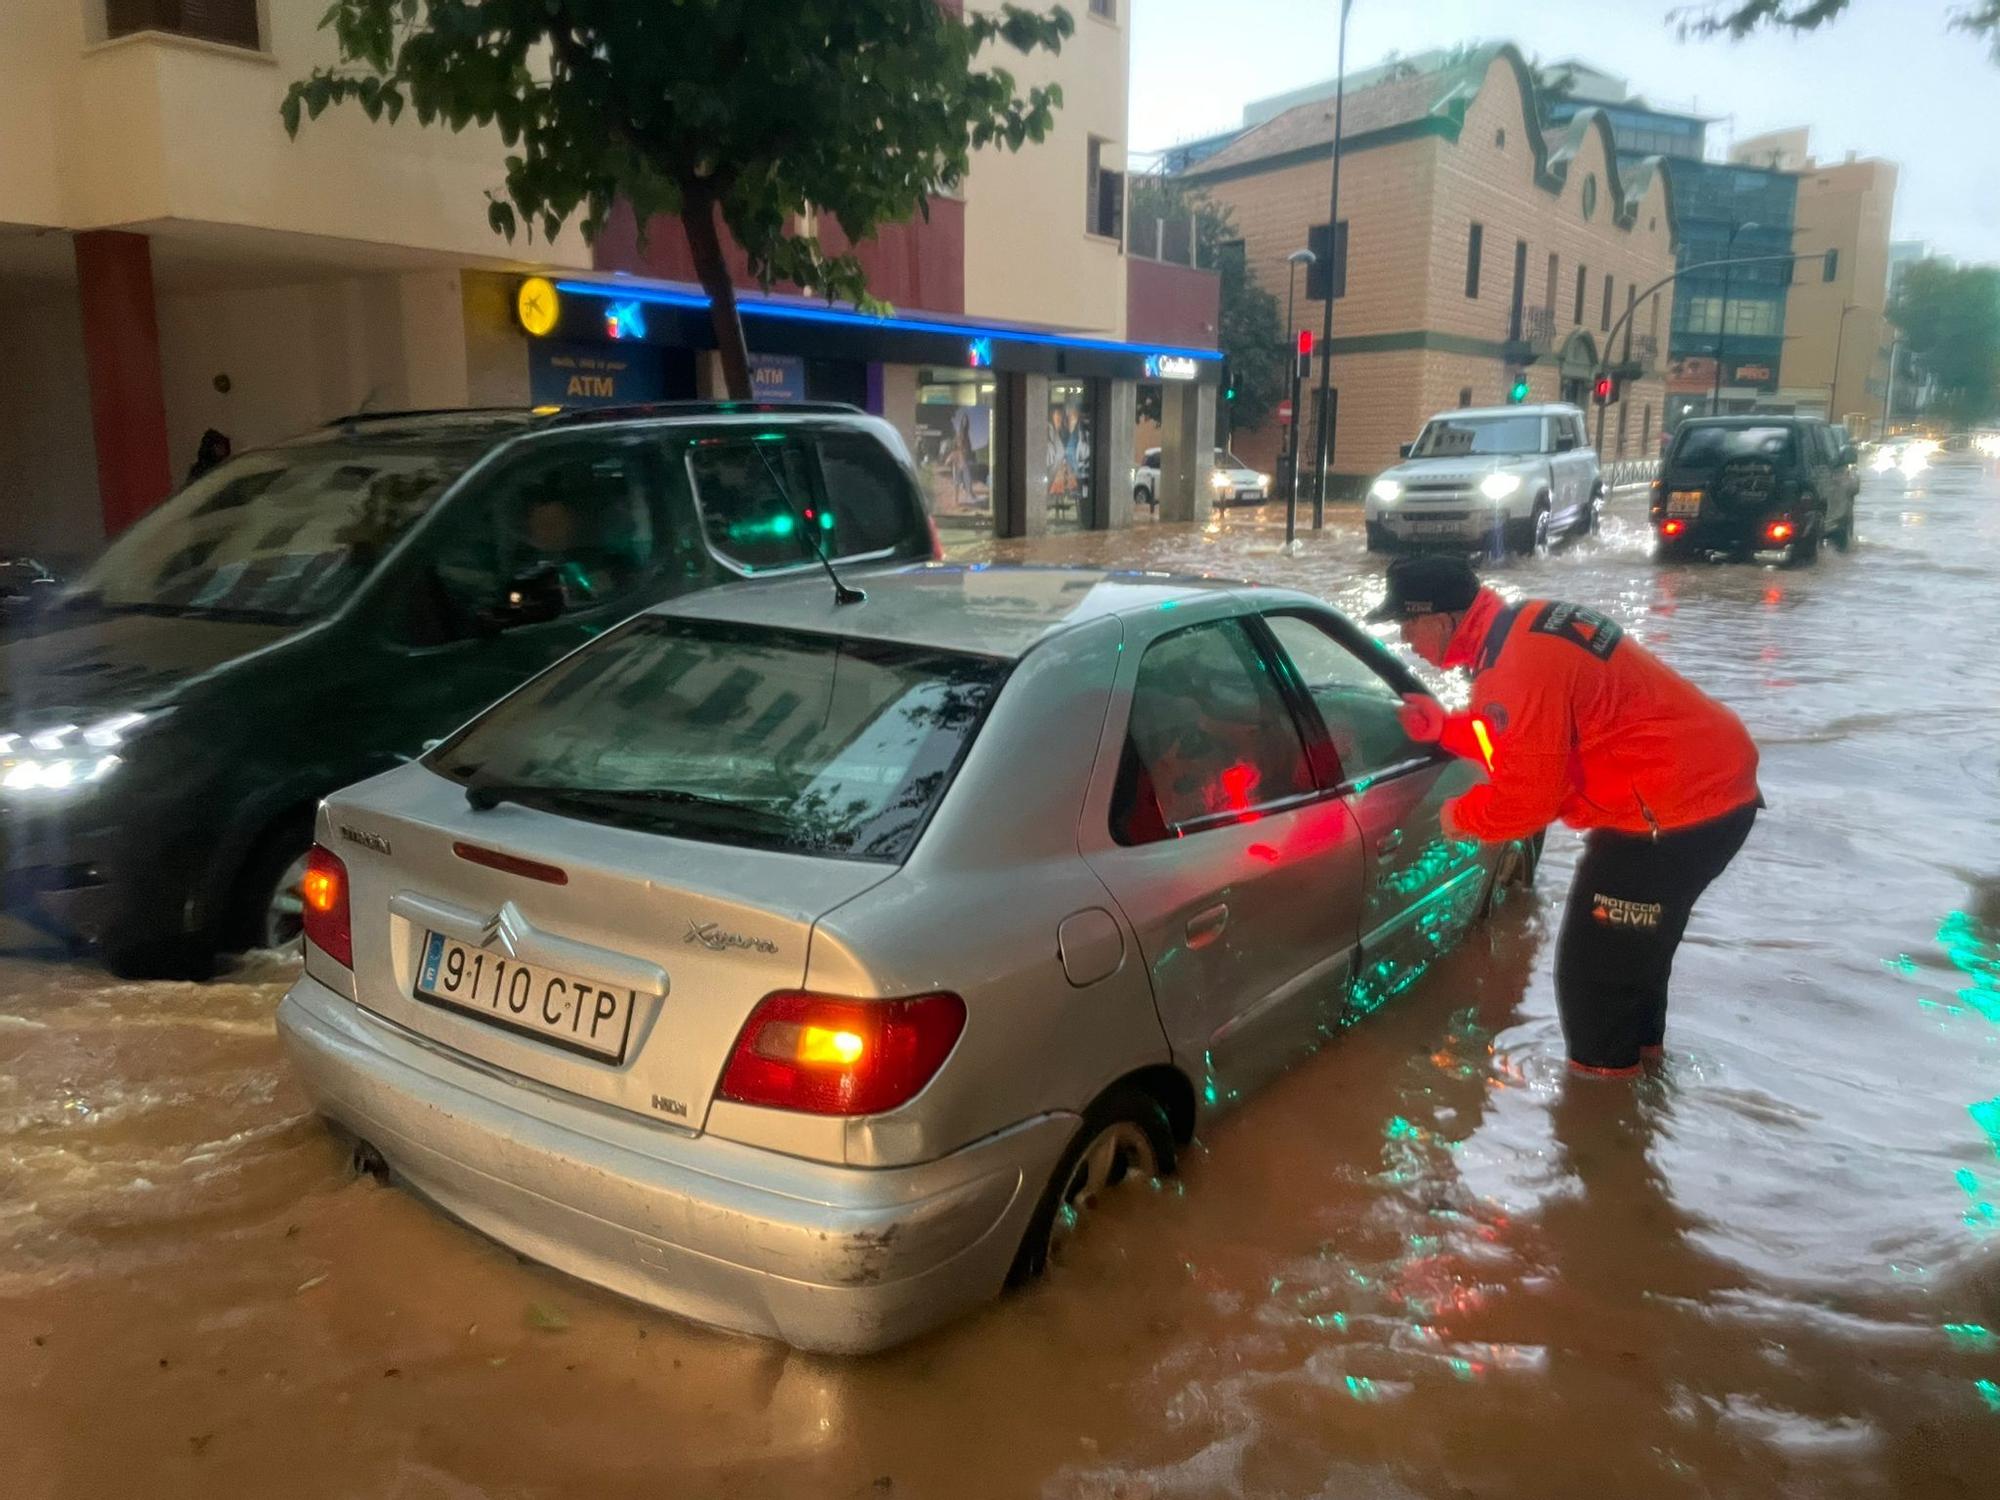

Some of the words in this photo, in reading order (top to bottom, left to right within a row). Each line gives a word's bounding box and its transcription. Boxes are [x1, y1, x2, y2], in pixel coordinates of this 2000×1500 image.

[755, 368, 784, 385] ATM
[567, 376, 614, 397] ATM
[1609, 908, 1657, 926] CIVIL
[444, 947, 532, 1014] 9110
[542, 977, 617, 1038] CTP
